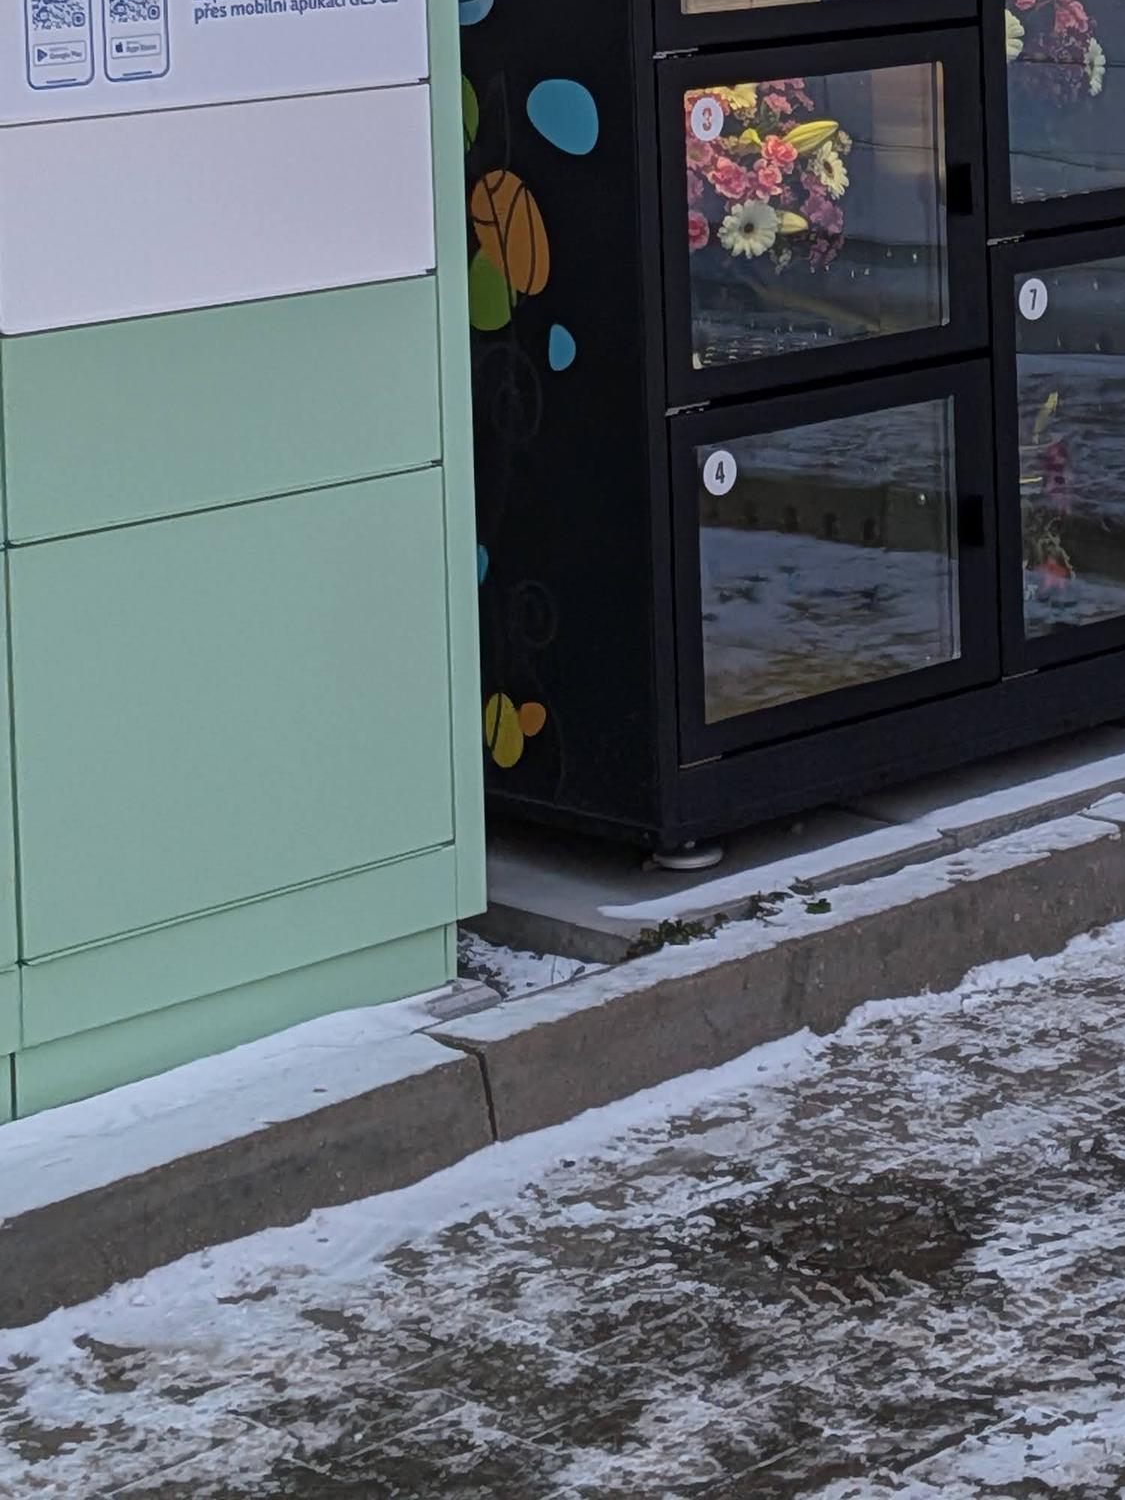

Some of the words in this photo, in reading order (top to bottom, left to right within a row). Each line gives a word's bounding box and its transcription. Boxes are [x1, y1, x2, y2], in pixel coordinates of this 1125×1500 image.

[194, 2, 227, 24] přes
[702, 107, 712, 132] 3
[1029, 288, 1038, 311] 7
[714, 459, 726, 484] 4
